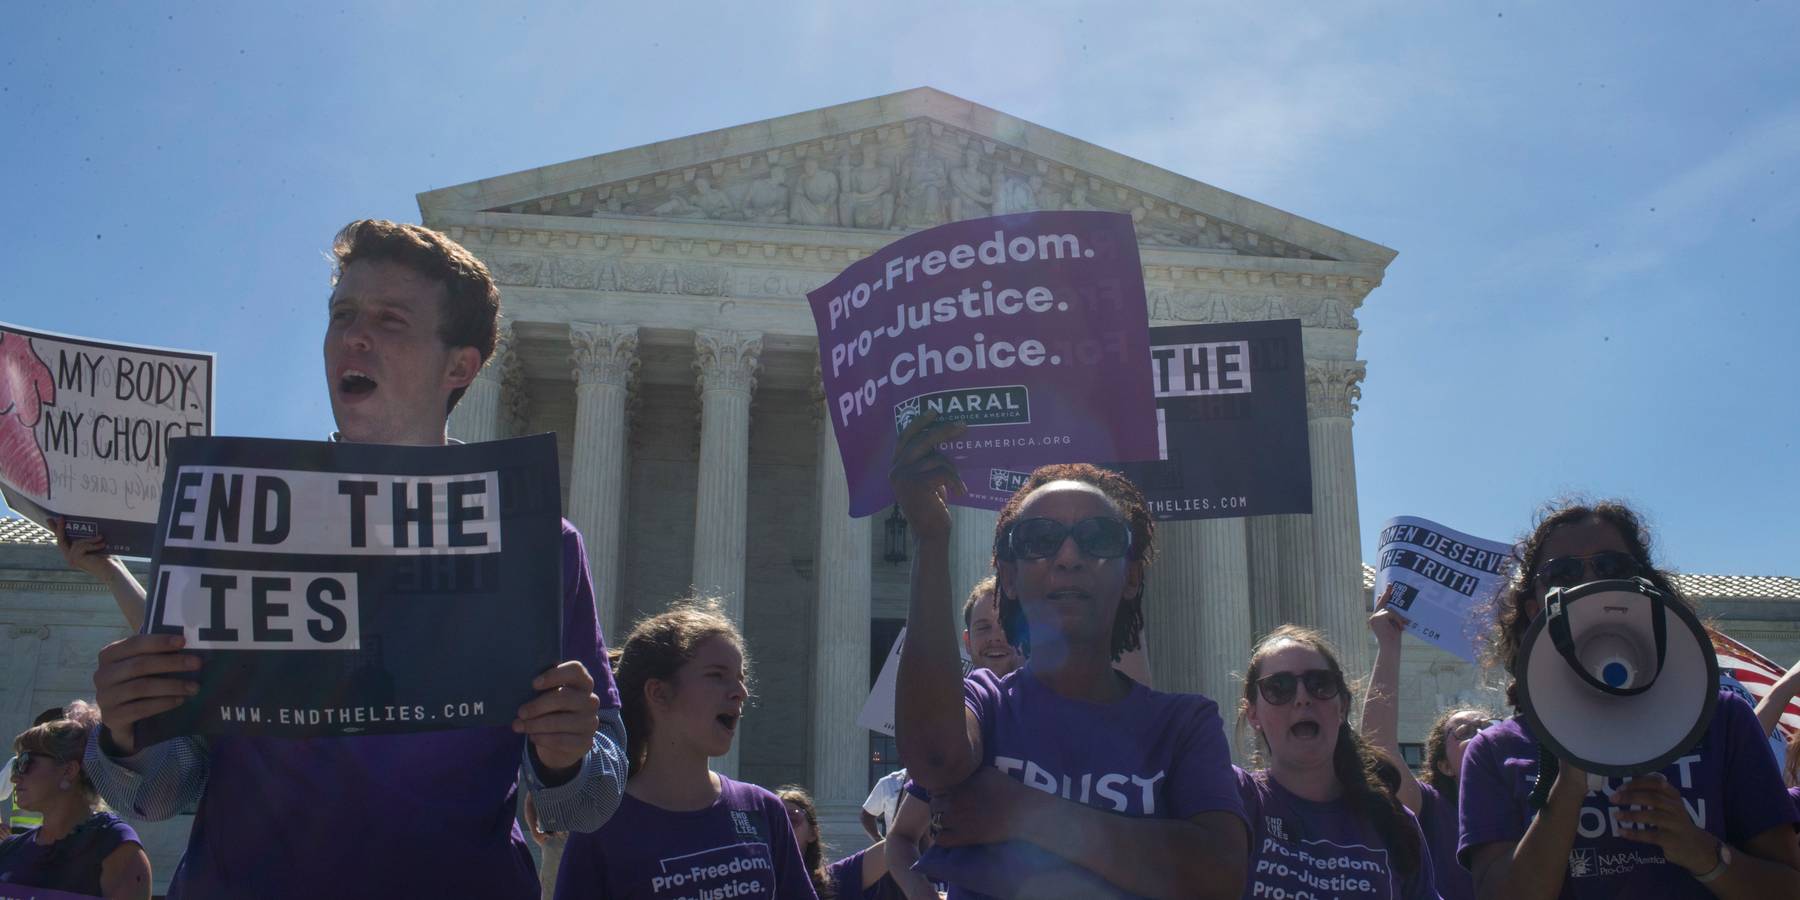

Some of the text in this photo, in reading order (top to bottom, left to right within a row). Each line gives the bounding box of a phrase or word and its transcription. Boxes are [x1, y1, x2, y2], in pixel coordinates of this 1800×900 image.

[829, 231, 1095, 330] Pro-Freedom.
[832, 281, 1069, 378] Pro-Justice.
[58, 349, 105, 397] MY
[838, 333, 1061, 428] Pro-Choice.
[1151, 345, 1243, 393] THE
[927, 392, 1020, 414] NARAL
[936, 412, 980, 423] O-CHOICE
[44, 410, 85, 458] MY
[937, 434, 1072, 450] OICEAMERICA.ORG
[168, 472, 292, 545] END
[338, 479, 488, 549] THE
[1147, 496, 1247, 512] THELIES.COM
[65, 521, 94, 533] ARAL
[1381, 550, 1477, 595] THE TRUTH
[150, 571, 348, 643] LIES
[220, 701, 486, 725] WWW.ENDTHELIES.COM
[1262, 839, 1385, 874] Pro-Freedom.
[1600, 864, 1634, 876] Pro-Cho
[651, 857, 771, 893] Pro-Freedom.
[673, 880, 766, 900] -Justice.
[1253, 881, 1340, 900] Pro-Ch
[1256, 860, 1377, 893] Pro-Justice.
